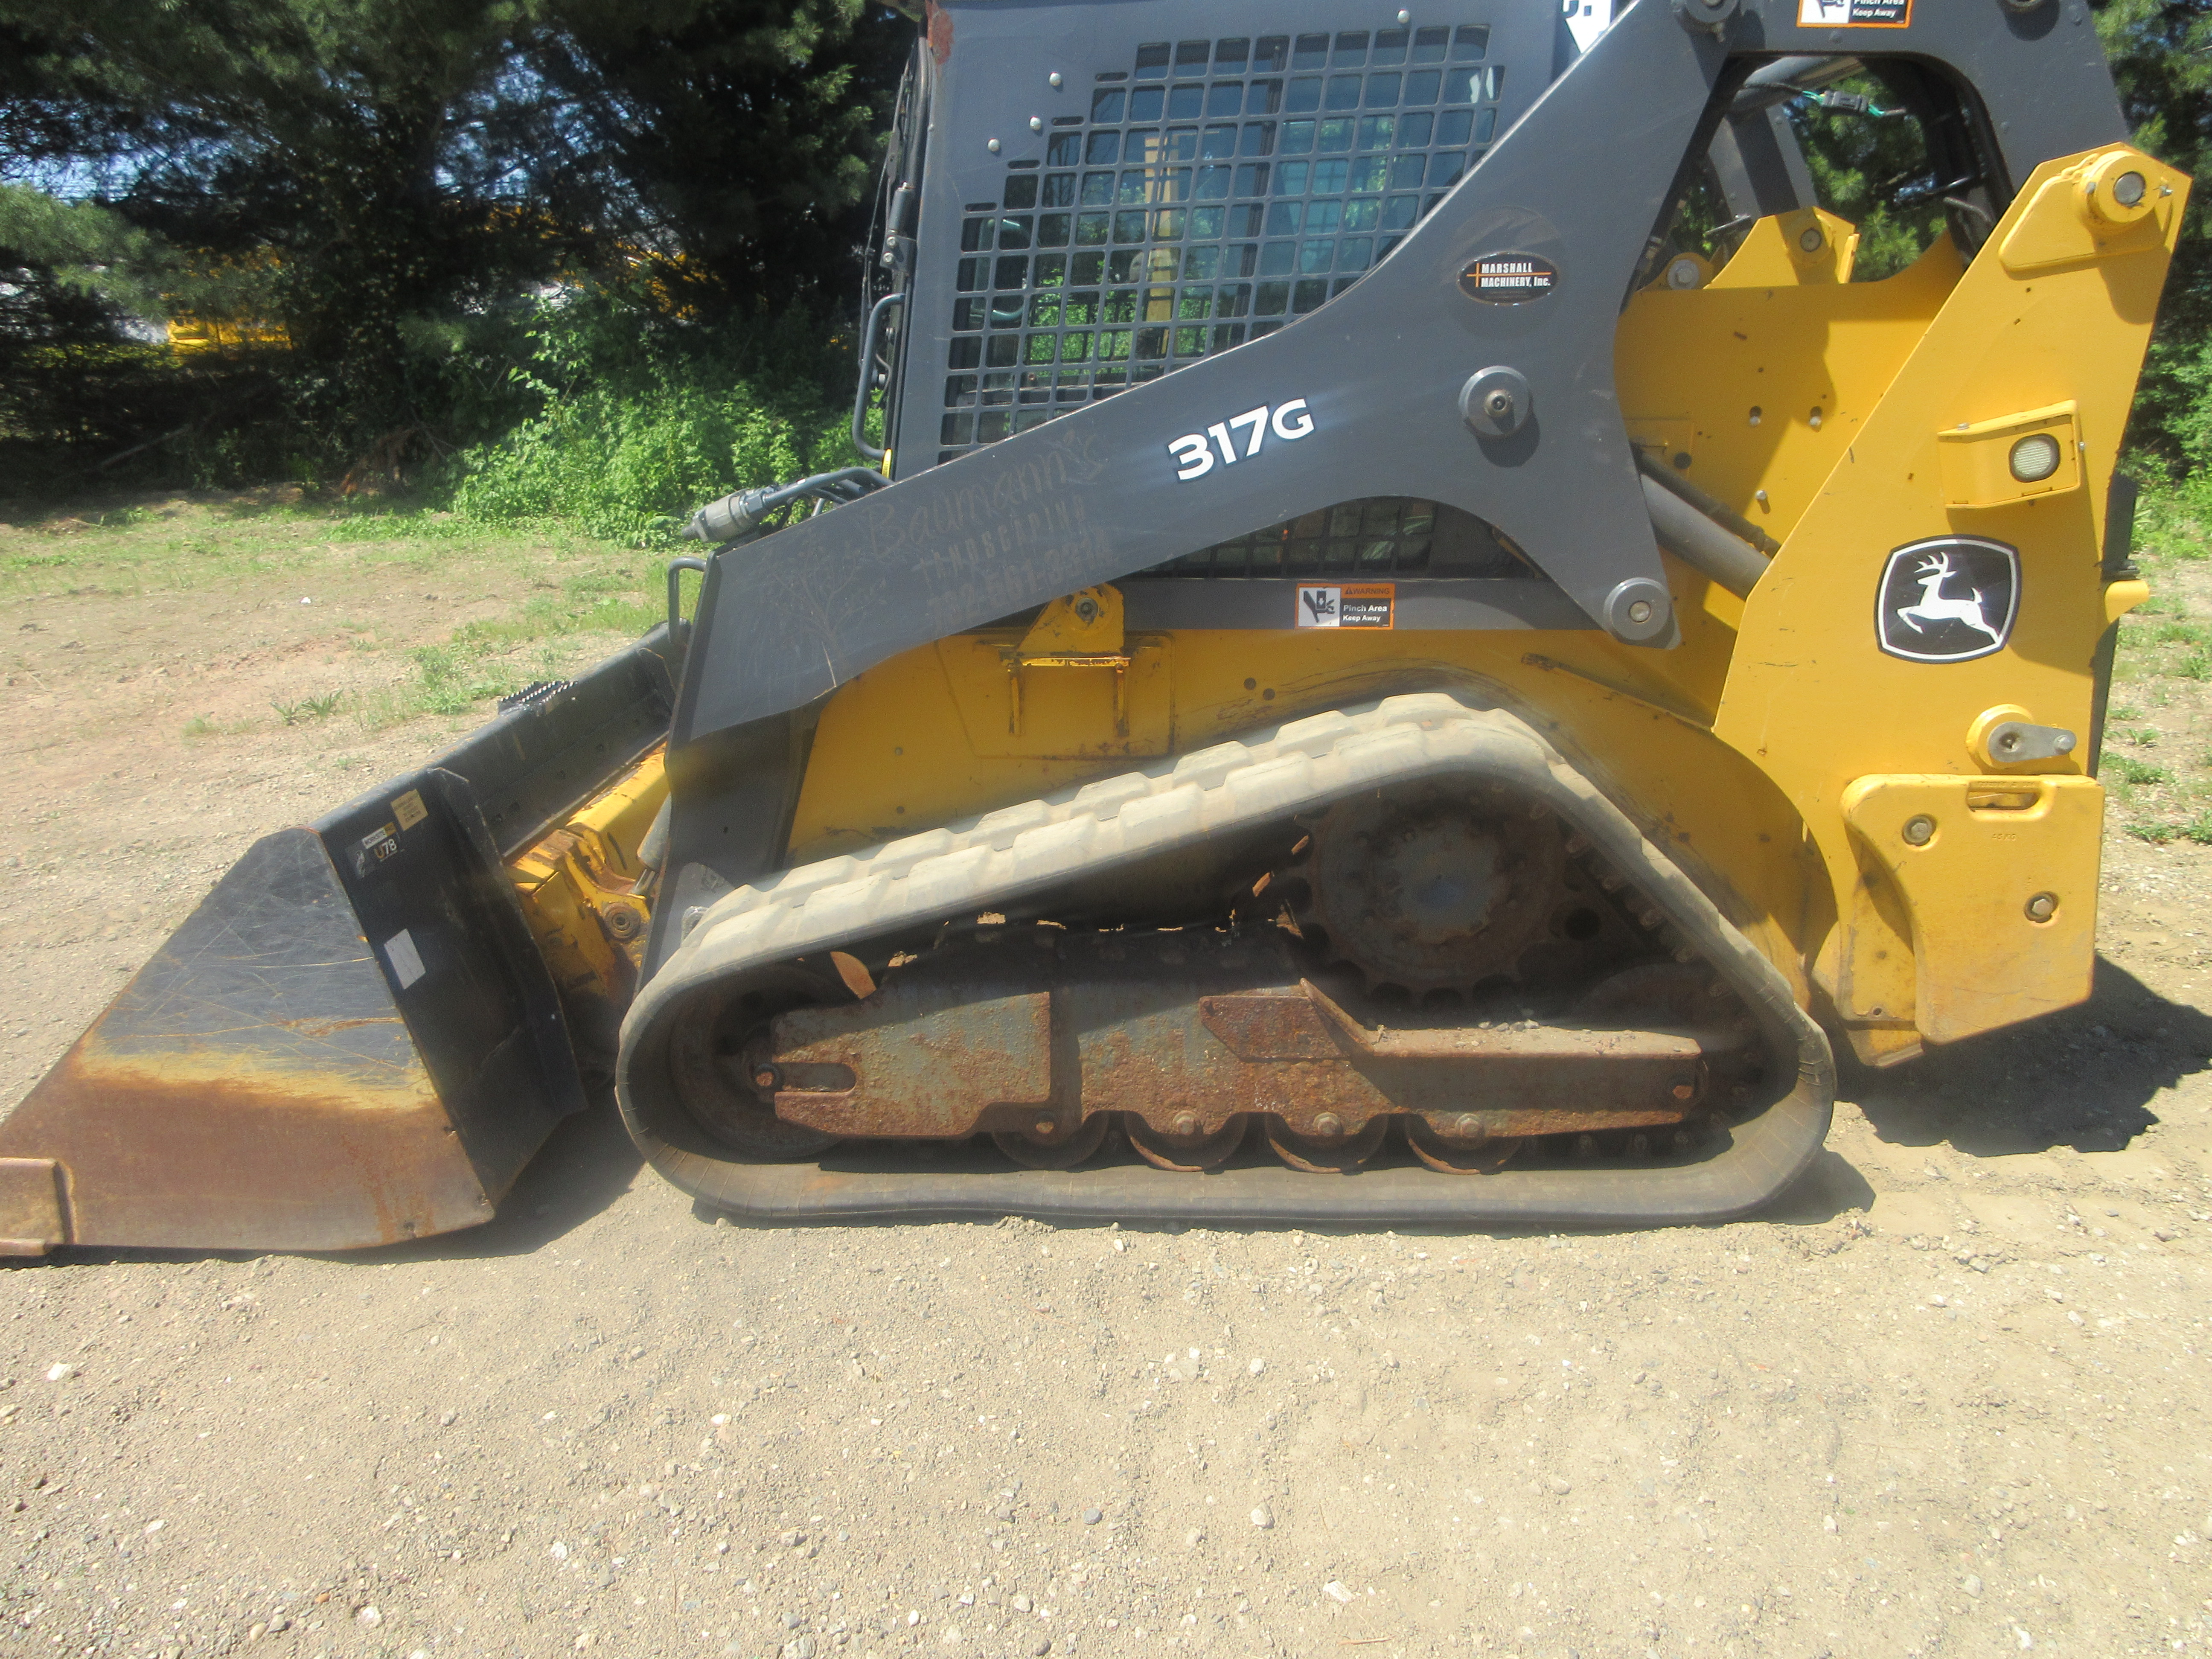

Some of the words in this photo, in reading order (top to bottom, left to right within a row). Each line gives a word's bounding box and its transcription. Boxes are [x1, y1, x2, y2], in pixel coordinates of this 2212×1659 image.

[1852, 8, 1873, 18] Keep
[1874, 9, 1896, 18] Away
[1481, 262, 1533, 274] MARSHALL
[1481, 276, 1532, 288] MACHINERY,
[1534, 276, 1551, 286] Inc.
[1167, 397, 1315, 481] 317G
[374, 838, 397, 859] U78
